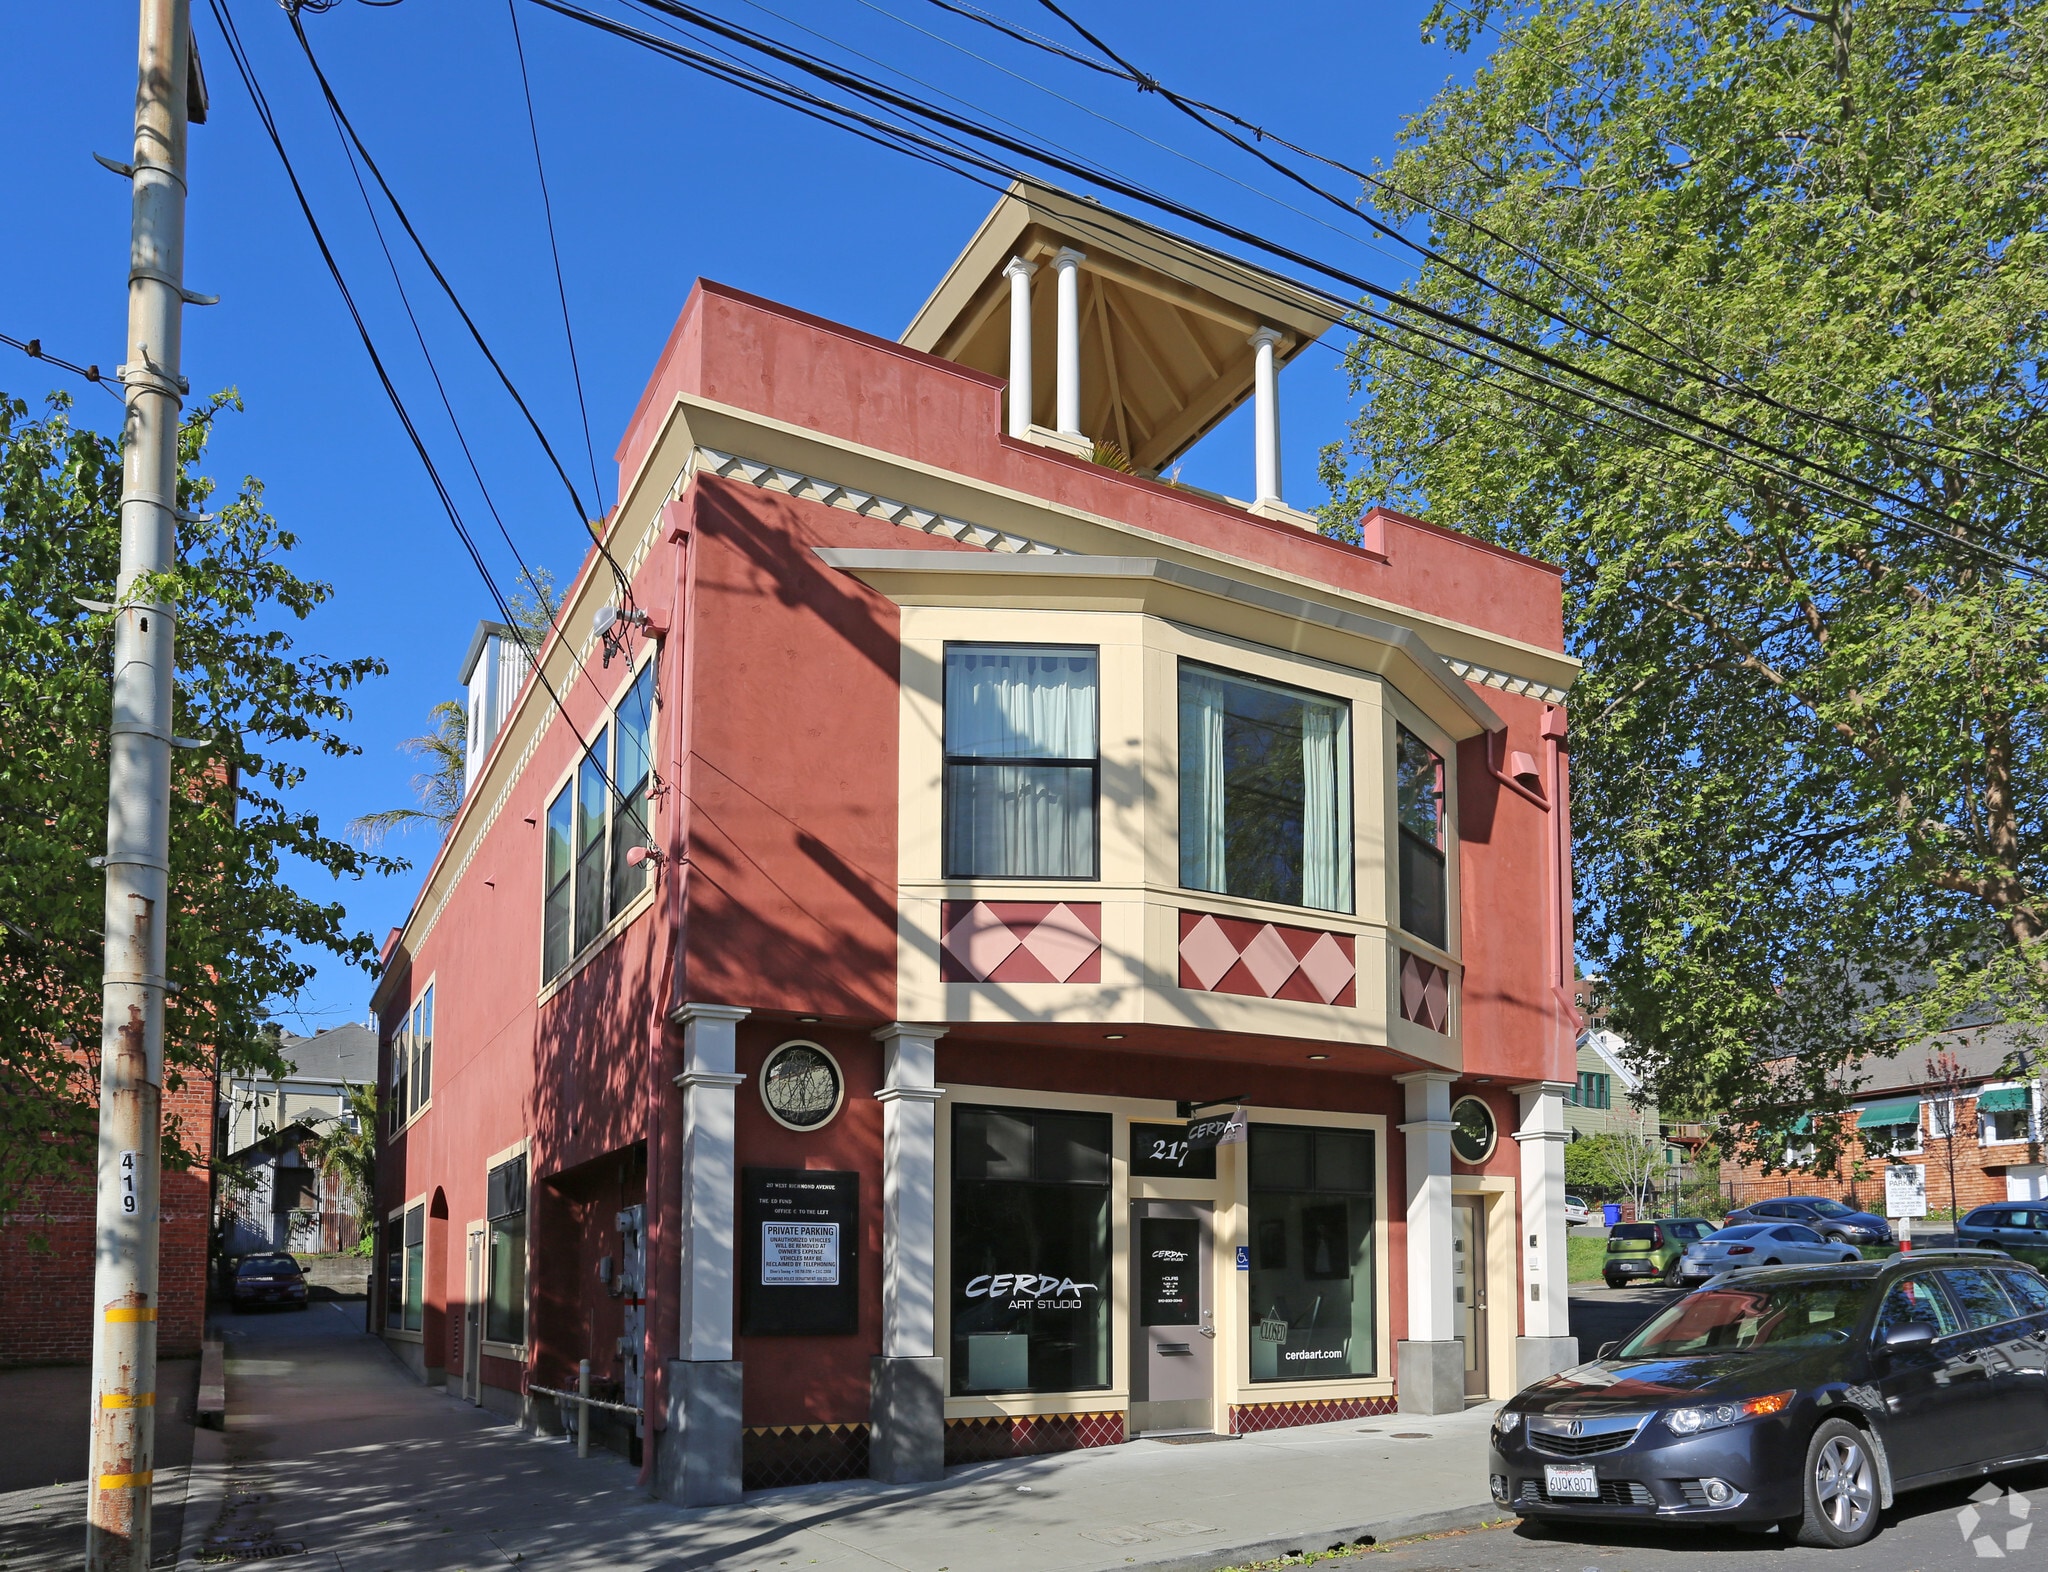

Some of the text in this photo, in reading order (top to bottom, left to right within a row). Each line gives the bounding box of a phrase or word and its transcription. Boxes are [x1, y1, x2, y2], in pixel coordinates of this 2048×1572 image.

[1188, 1120, 1242, 1140] CERDA
[1149, 1140, 1189, 1168] 217
[122, 1153, 135, 1212] 419
[768, 1226, 834, 1236] PRIVATE PARKING
[965, 1273, 1098, 1298] CERDA
[1008, 1299, 1082, 1309] ART STUDIO
[1261, 1322, 1286, 1341] CLOSED
[1285, 1350, 1342, 1360] cerdaart.com
